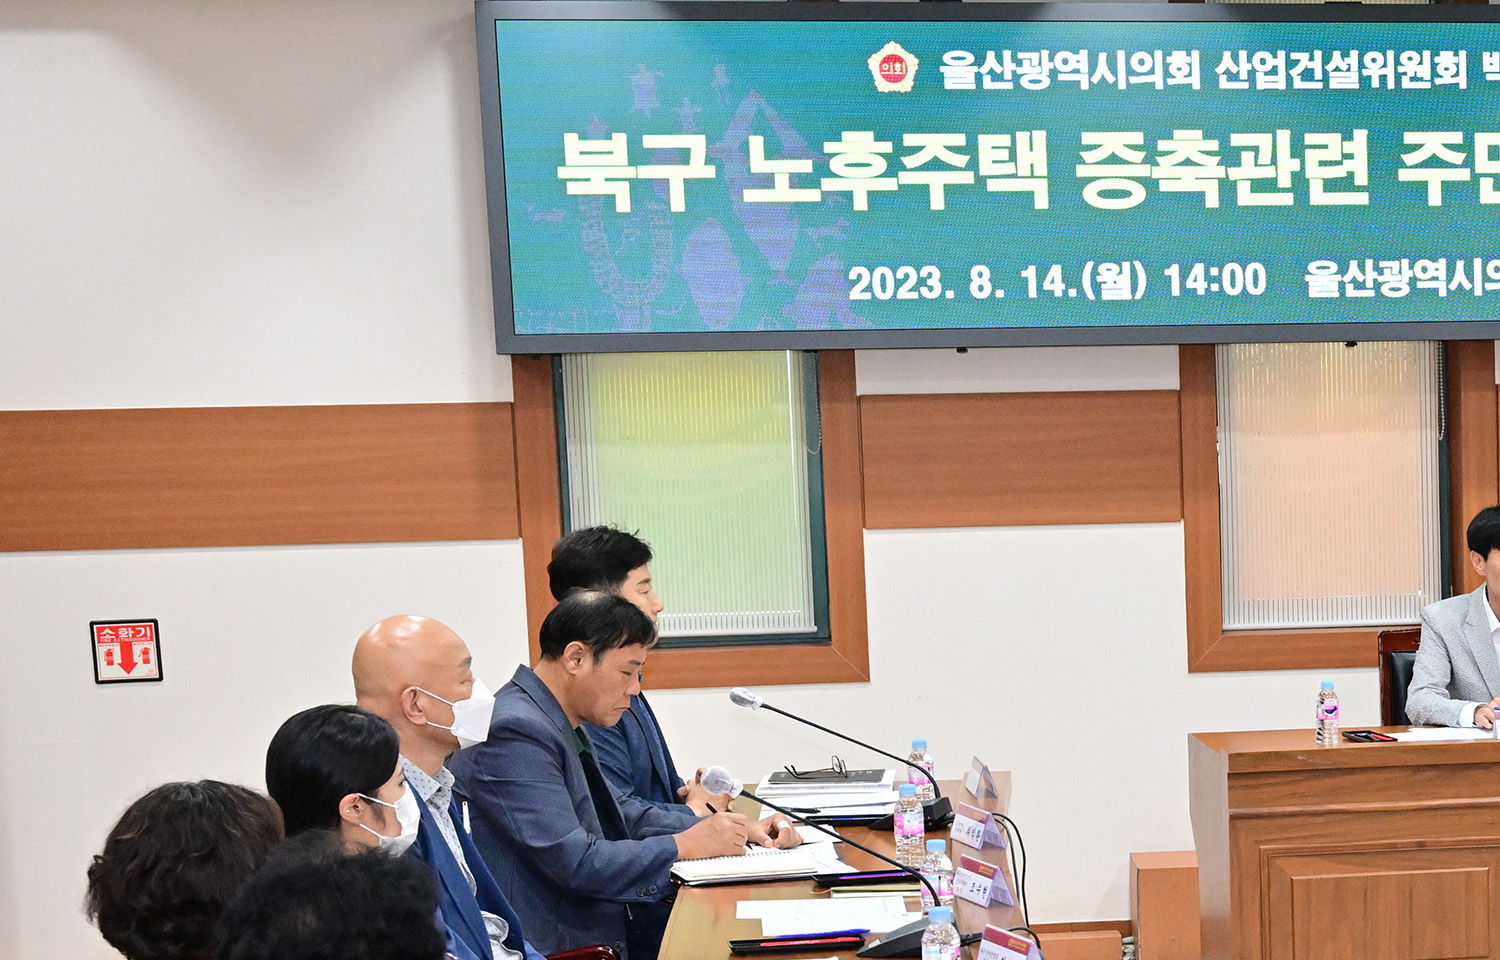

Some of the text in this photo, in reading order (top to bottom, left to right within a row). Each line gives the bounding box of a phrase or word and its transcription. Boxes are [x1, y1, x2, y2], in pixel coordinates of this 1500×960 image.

[880, 62, 906, 75] 의회
[939, 49, 1201, 91] 울산광역시의회
[1215, 50, 1468, 90] 산업건설위원회
[557, 132, 716, 213] 북구
[743, 130, 1049, 212] 노후주택
[1075, 129, 1370, 210] 증축관련
[848, 265, 955, 300] 2023.
[969, 265, 1005, 299] 8.
[1021, 260, 1147, 301] 14.(월)
[1164, 262, 1267, 297] 14:00
[100, 627, 150, 639] 소화기
